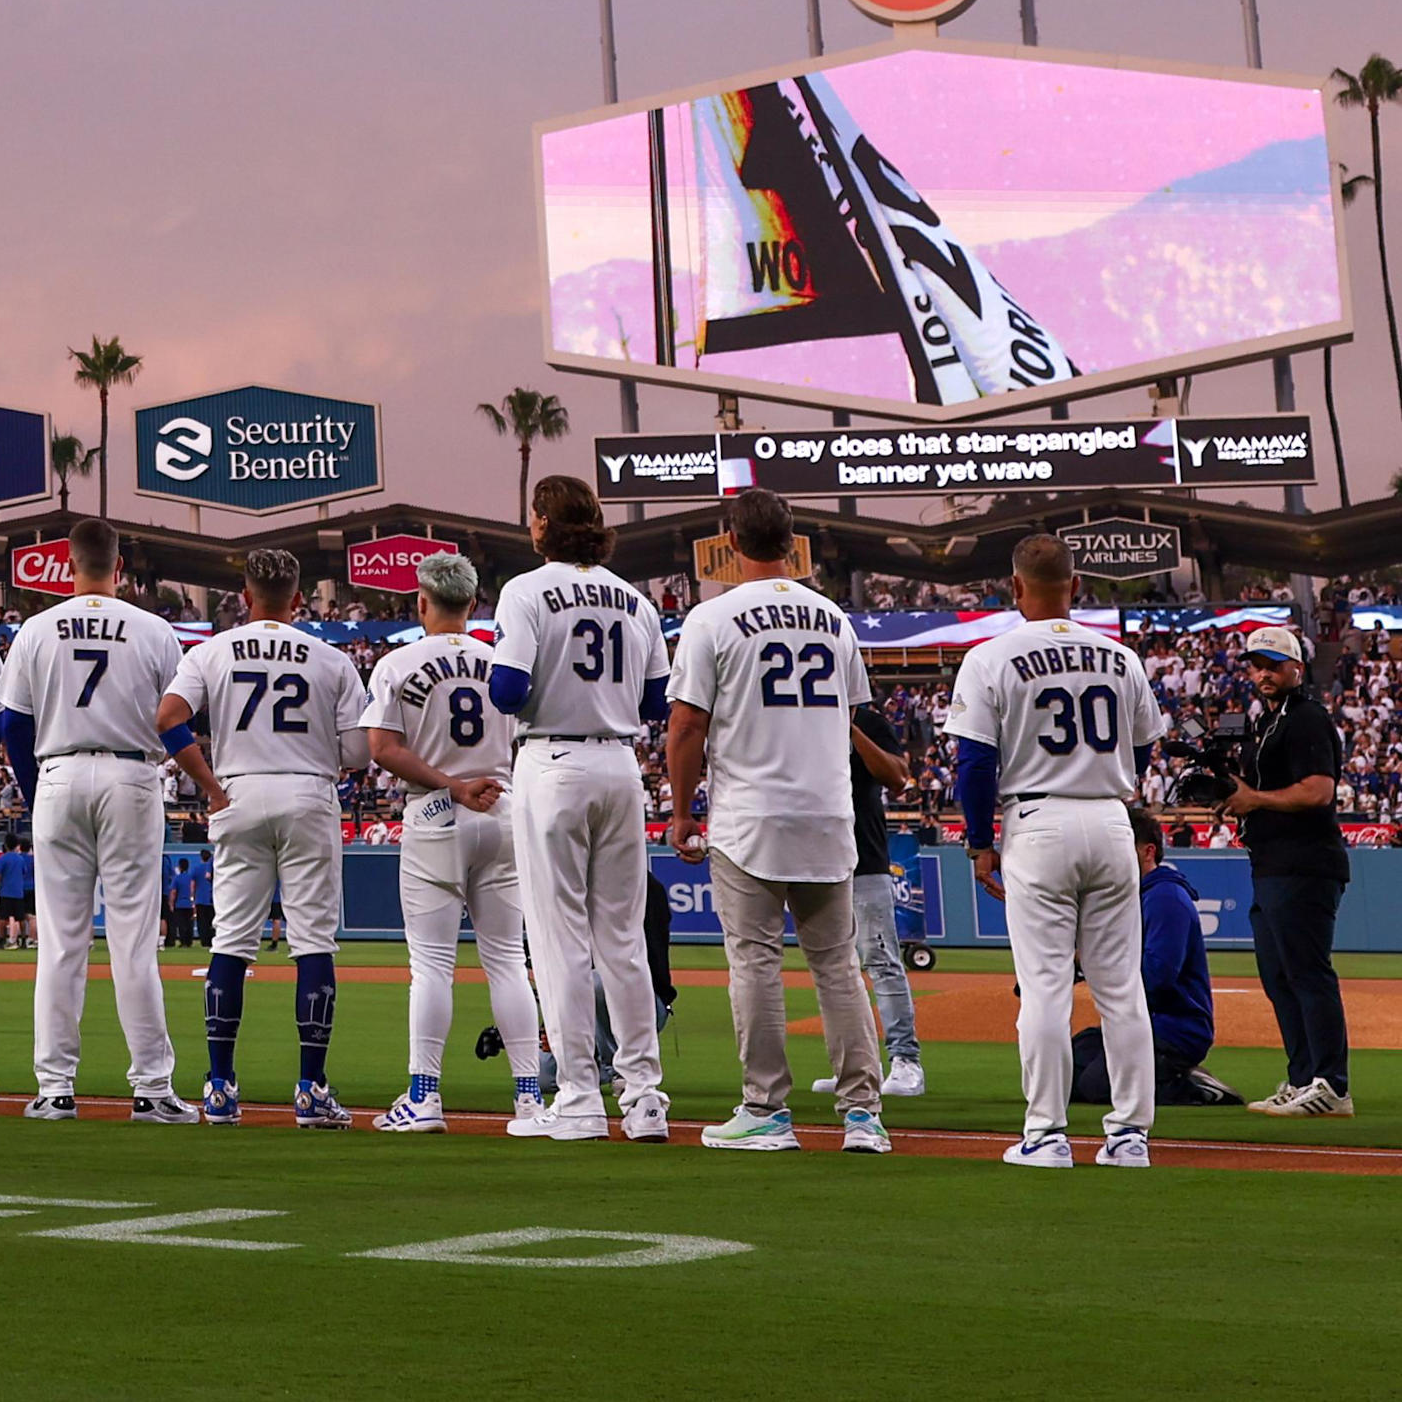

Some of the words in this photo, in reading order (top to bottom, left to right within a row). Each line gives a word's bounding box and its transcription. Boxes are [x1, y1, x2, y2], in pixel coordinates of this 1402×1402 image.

[227, 414, 356, 450] Security
[755, 437, 776, 459] O
[781, 439, 825, 462] say
[831, 435, 893, 458] does
[898, 432, 952, 455] that
[956, 426, 1136, 456] star-spangled
[228, 448, 342, 482] Benefit
[838, 461, 933, 485] banner
[936, 460, 978, 487] yet
[982, 460, 1053, 480] wave
[353, 552, 427, 567] DAISO
[1064, 533, 1173, 551] STARLUX
[1082, 551, 1158, 564] AIRLINES
[354, 568, 388, 577] JAPAN
[542, 582, 640, 618] GLASNOW
[56, 617, 127, 643] SNELL
[732, 603, 842, 639] KERSHAW
[232, 638, 310, 664] ROJAS
[571, 618, 624, 685] 31
[1010, 646, 1127, 683] ROBERTS
[73, 648, 109, 708] 7
[760, 641, 839, 708] 22
[232, 671, 309, 734] 72
[448, 686, 484, 748] 8
[1035, 684, 1118, 756] 30
